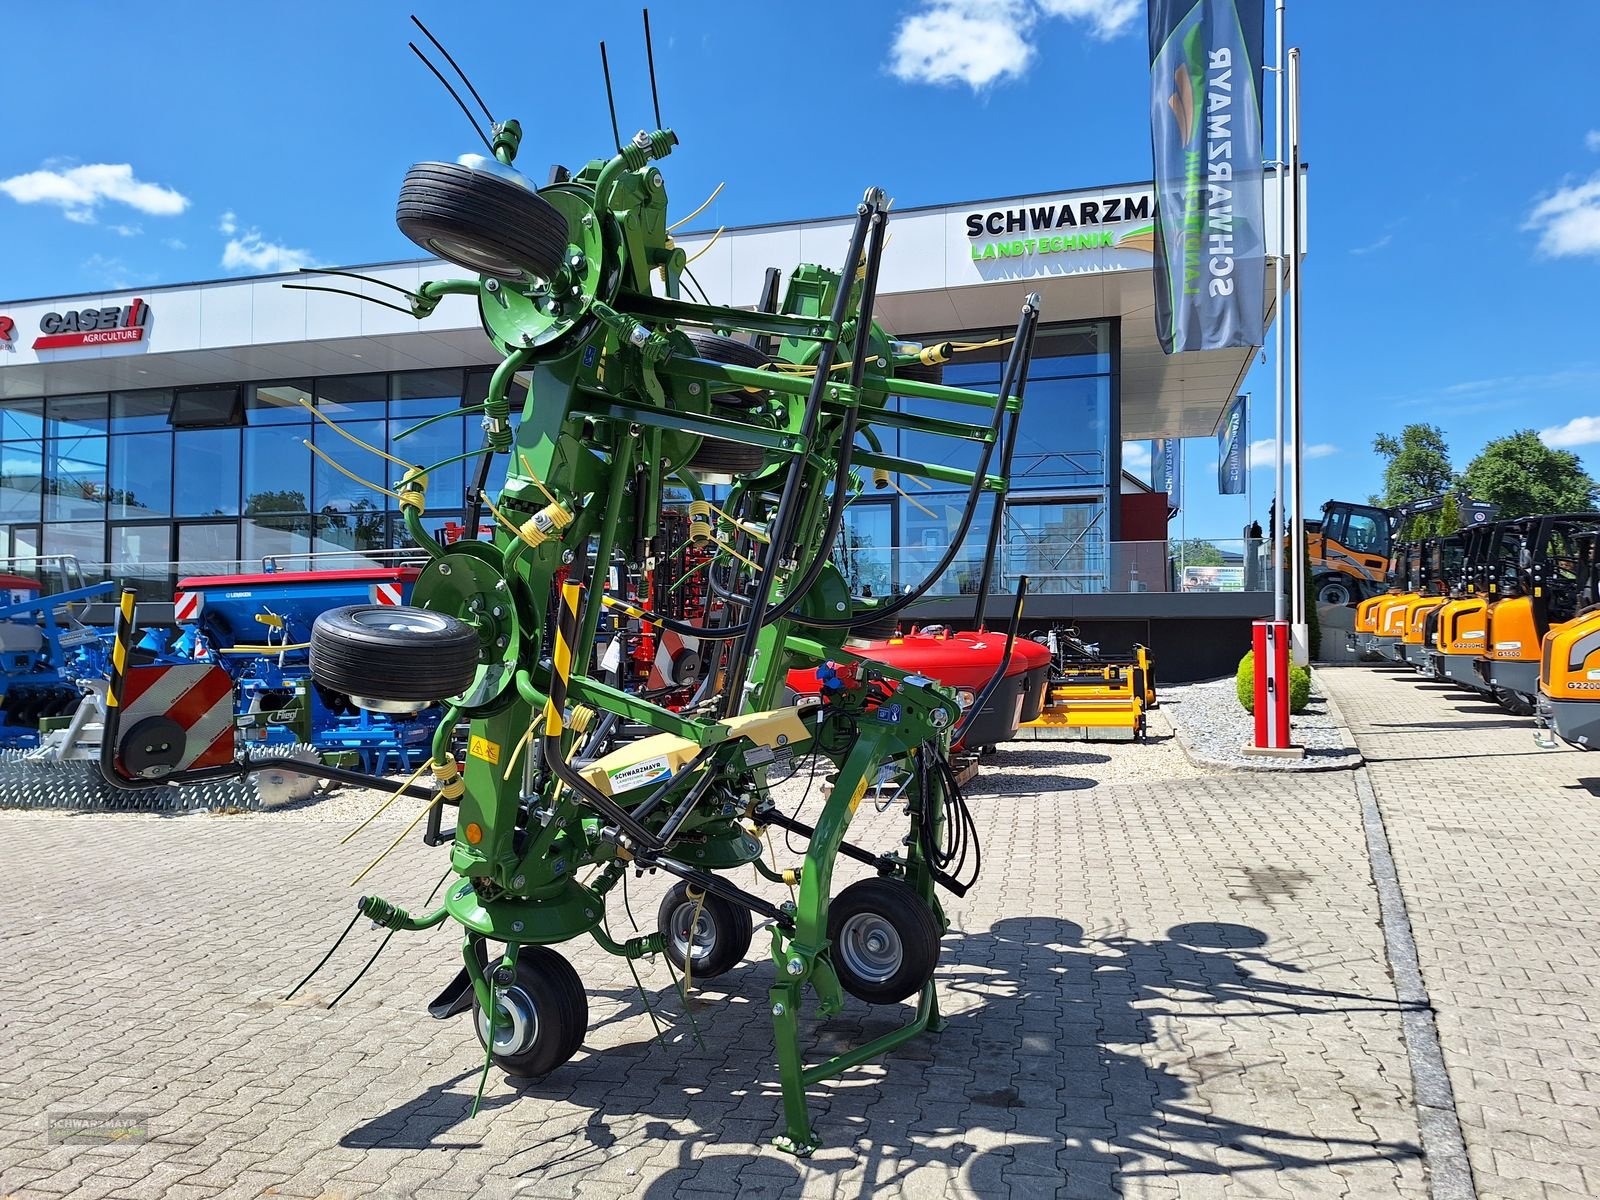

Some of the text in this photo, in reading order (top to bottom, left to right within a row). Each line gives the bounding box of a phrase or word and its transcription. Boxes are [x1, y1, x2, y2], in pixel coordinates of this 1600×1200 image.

[971, 230, 1114, 260] LANDTECHNIK
[40, 306, 121, 335] CASE
[83, 330, 137, 343] AGRICULTURE
[276, 708, 298, 721] Fliegl
[614, 762, 661, 780] SCHWARZMAYR
